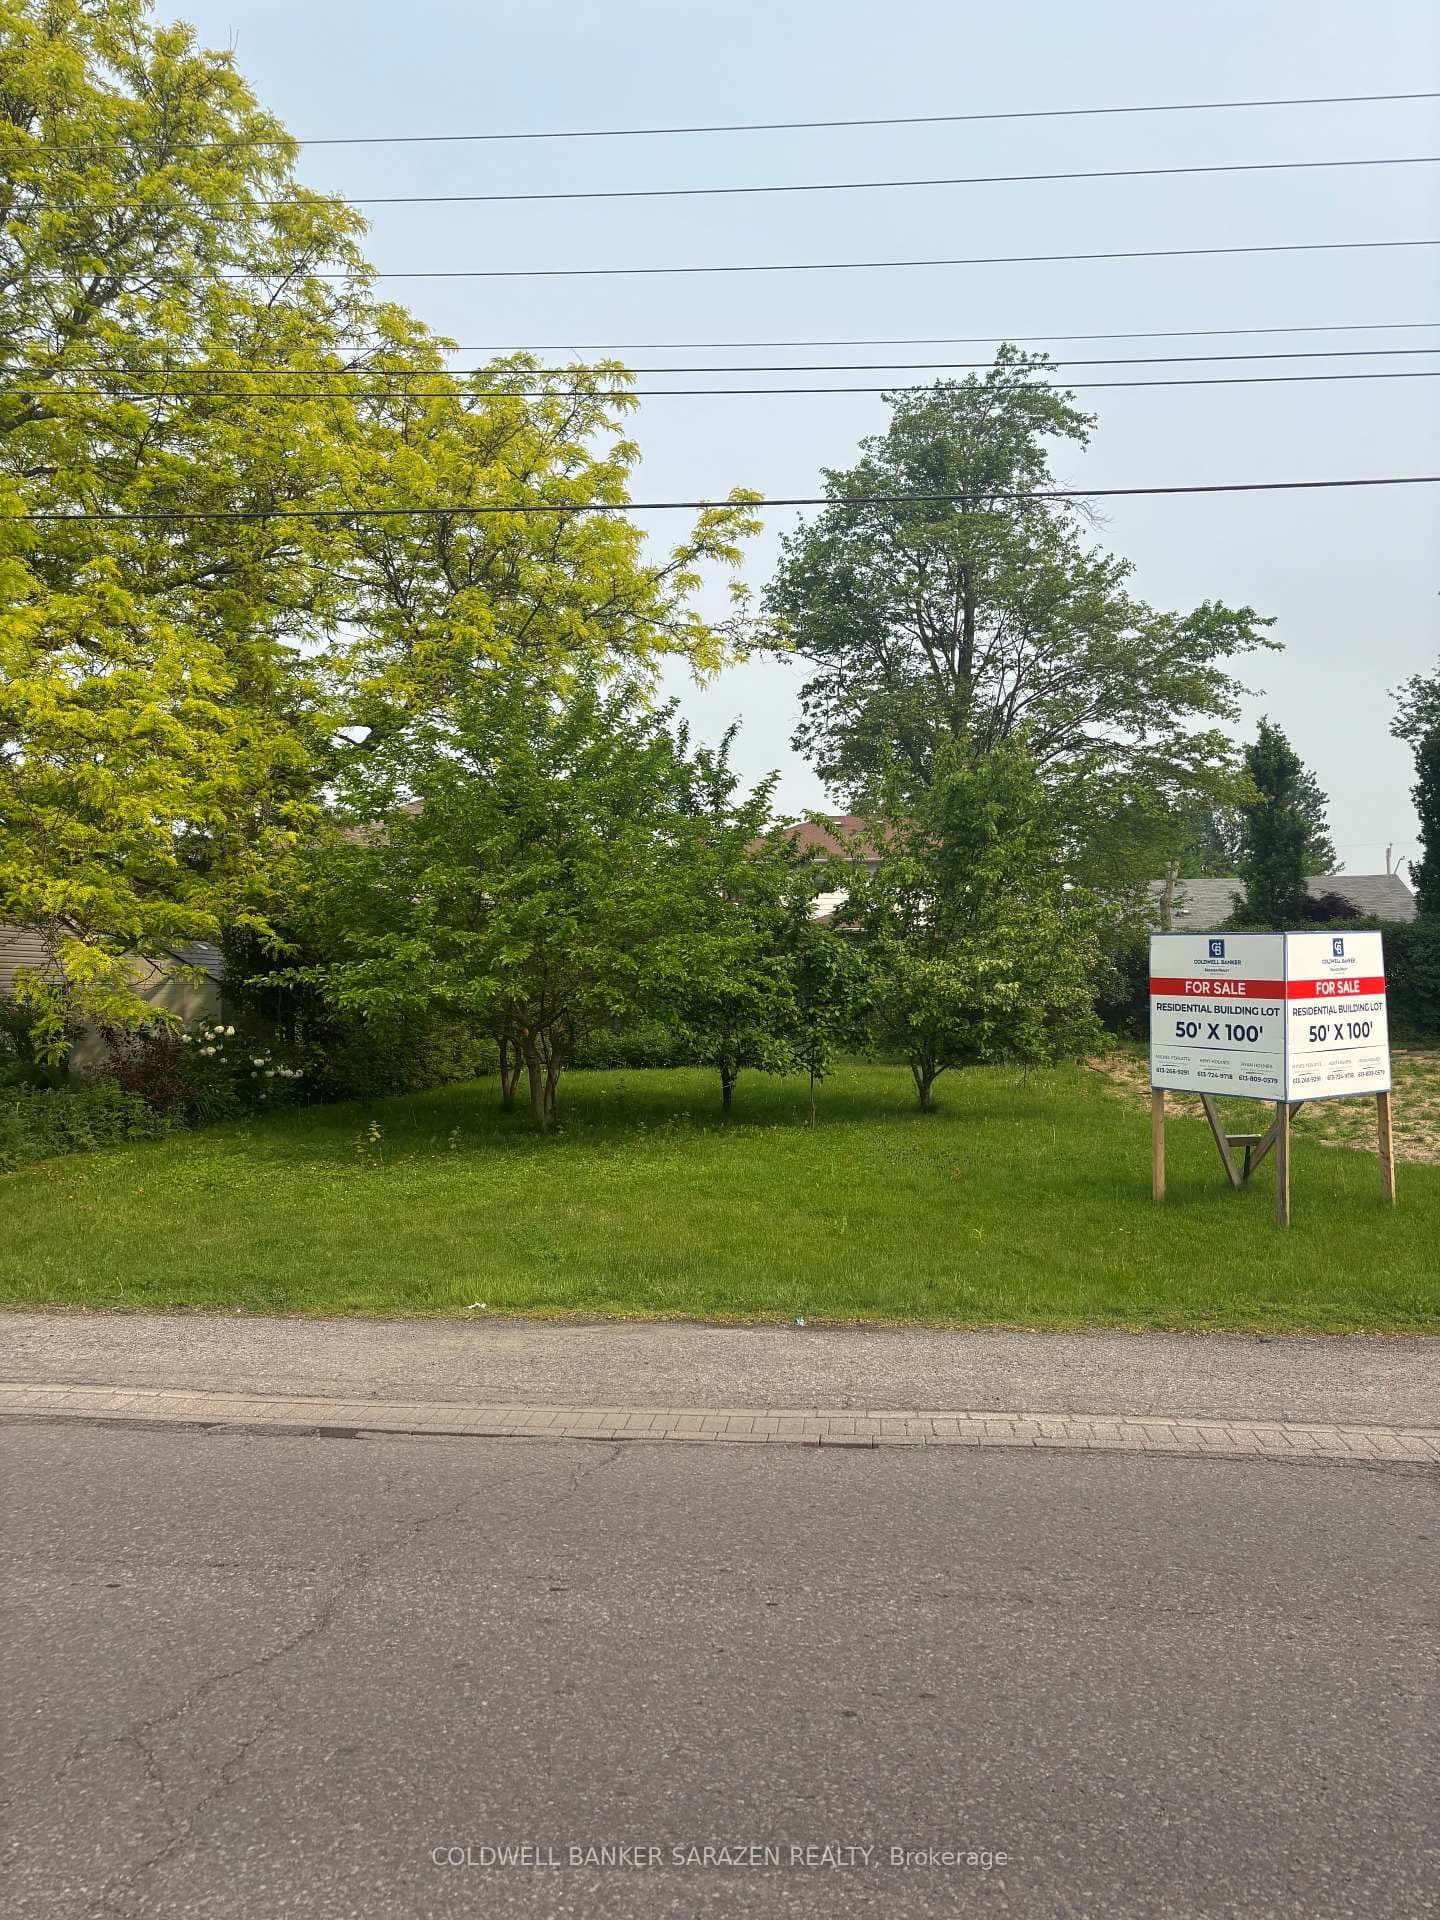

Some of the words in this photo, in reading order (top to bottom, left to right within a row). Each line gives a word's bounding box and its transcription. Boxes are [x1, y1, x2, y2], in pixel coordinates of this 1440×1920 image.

[1185, 981, 1210, 994] FOR
[1213, 982, 1246, 995] SALE
[1315, 982, 1335, 995] FOR
[1337, 980, 1360, 993] SALE
[1156, 1003, 1212, 1014] RESIDENTIAL
[1214, 1006, 1259, 1016] BUILDING
[1261, 1007, 1280, 1016] LOT
[1292, 1005, 1337, 1016] RESIDENTIAL
[1338, 1003, 1369, 1014] BUILDING
[1370, 1002, 1383, 1011] LOT
[1175, 1021, 1202, 1038] 50'
[1207, 1023, 1220, 1040] X
[1225, 1024, 1263, 1042] 100'
[1309, 1024, 1330, 1042] 50'
[1334, 1023, 1344, 1040] X
[1347, 1021, 1373, 1039] 100'
